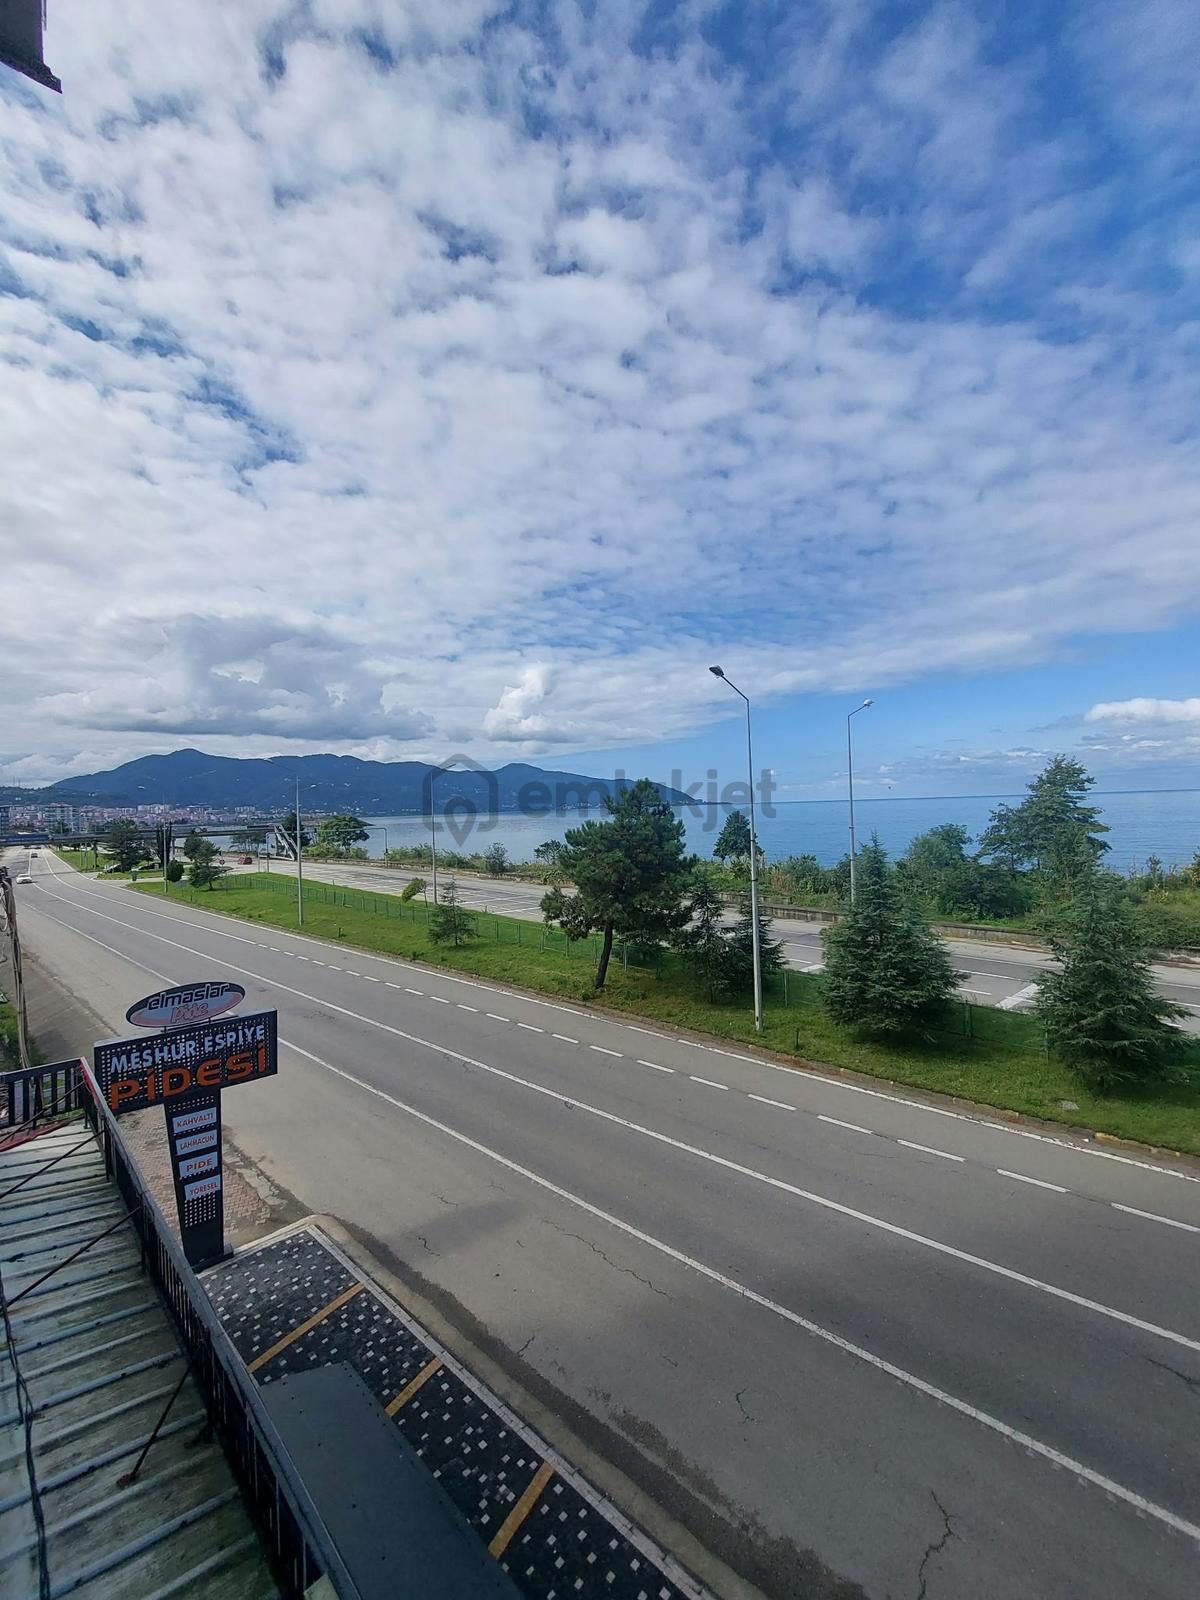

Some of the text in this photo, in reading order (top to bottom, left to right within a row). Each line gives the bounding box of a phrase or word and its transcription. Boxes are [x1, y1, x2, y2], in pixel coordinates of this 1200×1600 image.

[147, 983, 229, 1010] elmaslar
[176, 1113, 213, 1128] KAHVALTI
[180, 1135, 214, 1150] LAHMACUN
